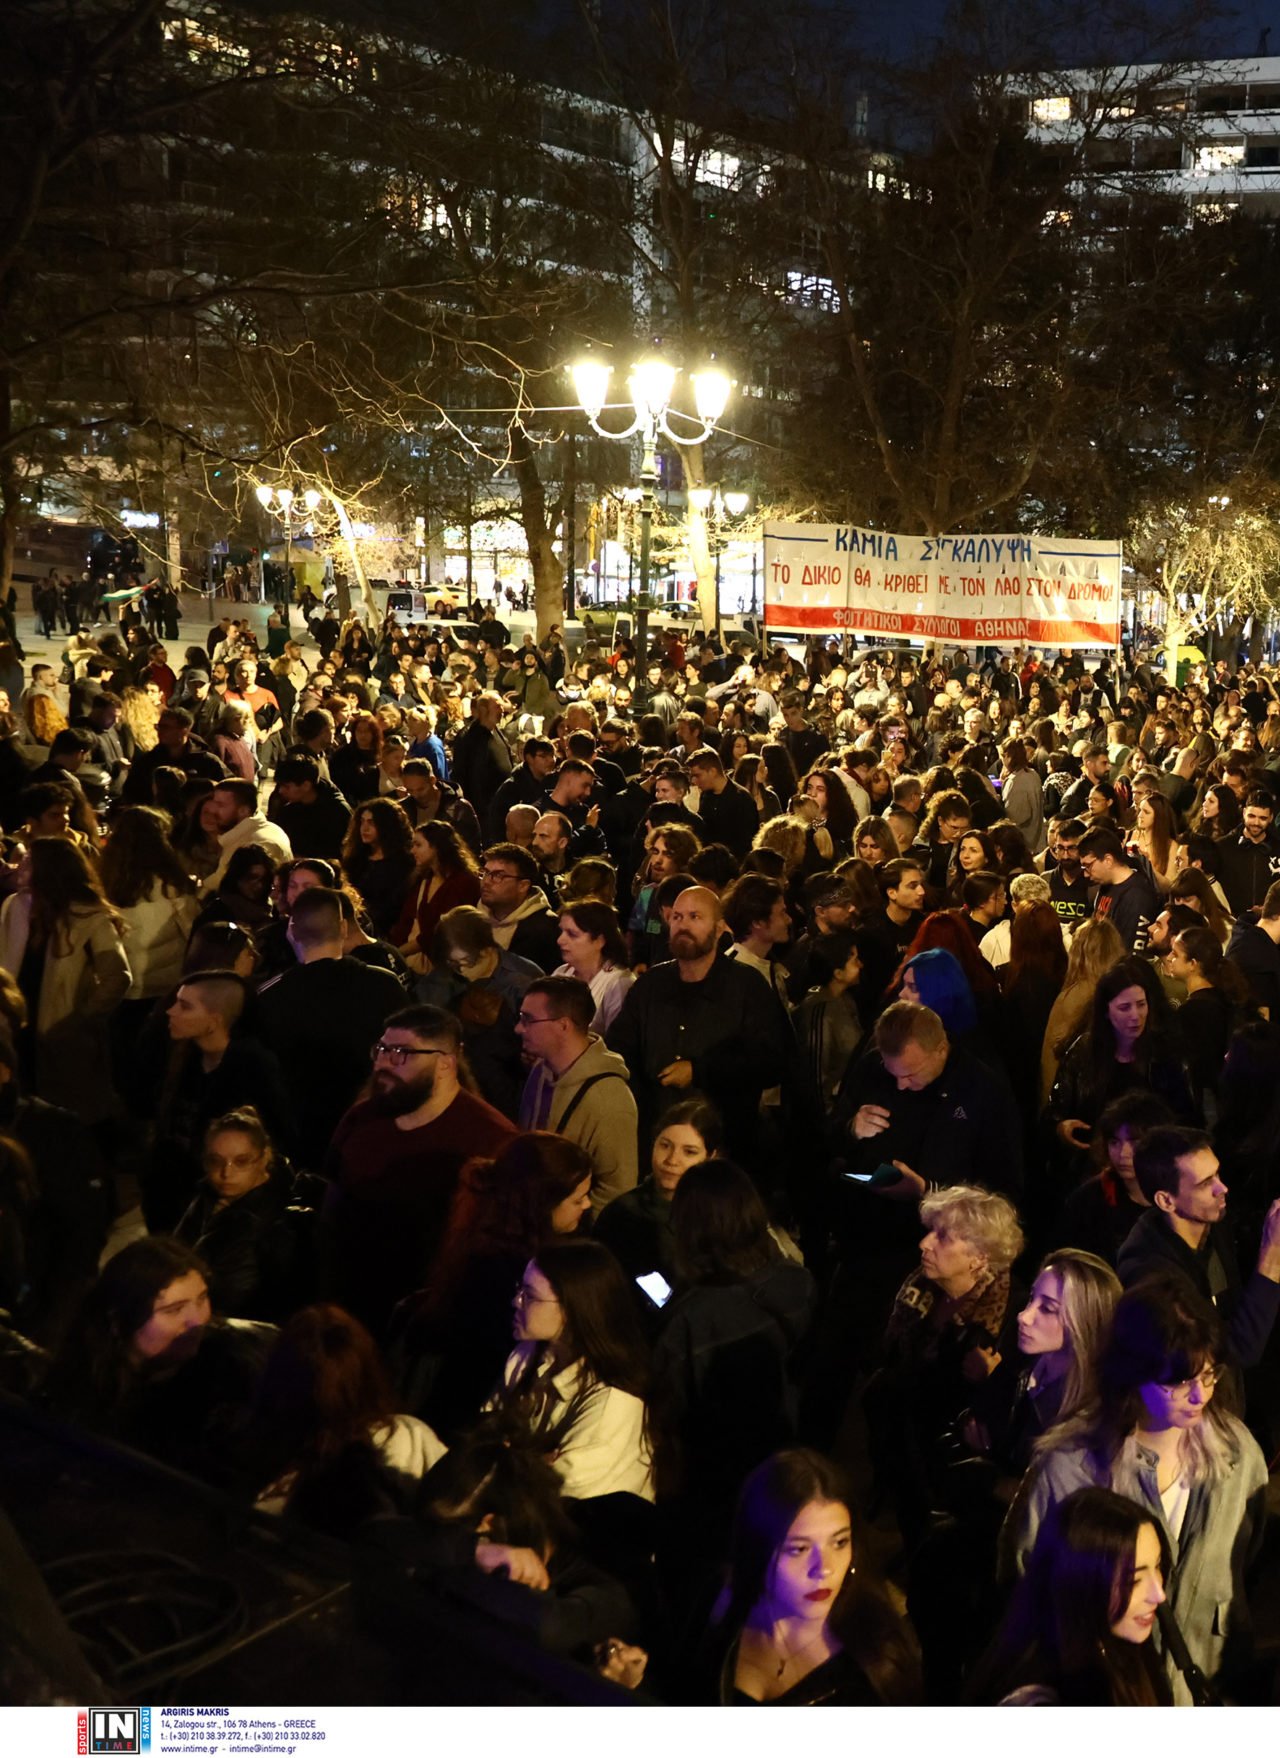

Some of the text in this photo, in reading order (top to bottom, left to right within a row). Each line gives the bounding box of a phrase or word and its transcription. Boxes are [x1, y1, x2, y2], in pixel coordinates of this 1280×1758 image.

[835, 528, 1032, 563] ΚΑΜΙΑ ΣΥΓΚΑΛΥΨΗ
[771, 563, 790, 584] ΤΟ
[801, 565, 841, 585] ΔΙΚΙΟ
[854, 567, 871, 587] ΘΑ
[883, 573, 928, 593] ΚΡΙΘΕΙ
[960, 577, 985, 596] ΤΟΝ
[994, 576, 1021, 596] ΛΑΟ
[1026, 577, 1061, 597] ΣΤΟΝ
